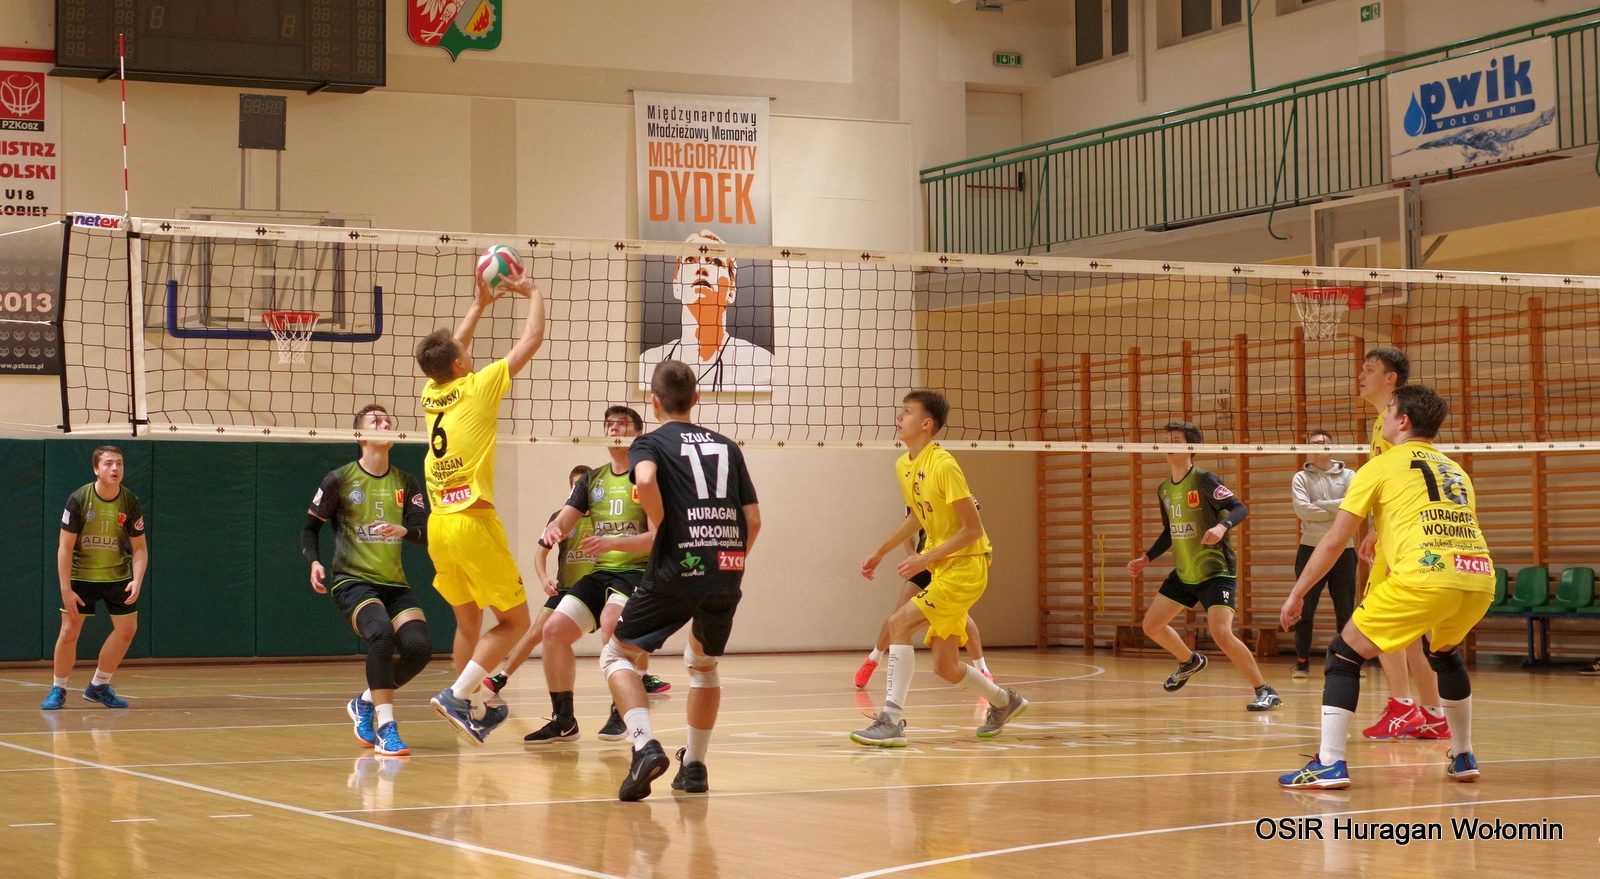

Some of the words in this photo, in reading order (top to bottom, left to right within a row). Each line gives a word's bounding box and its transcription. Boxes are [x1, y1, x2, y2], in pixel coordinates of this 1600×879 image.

[1420, 54, 1533, 120] pwik
[647, 105, 757, 126] Międzynarodowy
[1436, 105, 1517, 129] WOŁOMIN
[647, 122, 709, 142] Młodzieżowy
[711, 125, 757, 142] Memoriał
[0, 141, 56, 157] ISTRZ
[648, 141, 757, 170] MAŁGORZATY
[648, 170, 757, 224] DYDEK
[75, 215, 120, 229] netex
[0, 292, 53, 313] 013
[431, 411, 448, 459] 6
[680, 432, 715, 443] SZULC
[680, 443, 730, 500] 17
[1410, 459, 1469, 506] 18
[442, 487, 471, 504] ŻYCIE
[374, 501, 387, 519] 5
[608, 498, 625, 516] 10
[687, 506, 737, 521] HURAGAN
[1170, 503, 1182, 520] 14
[1420, 509, 1475, 525] HURAGAN
[100, 520, 110, 534] 11
[595, 521, 637, 532] AQUA
[688, 525, 740, 539] WOŁOMIN
[1422, 523, 1477, 540] WOŁOMIN
[1455, 554, 1491, 573] ŻYCIE
